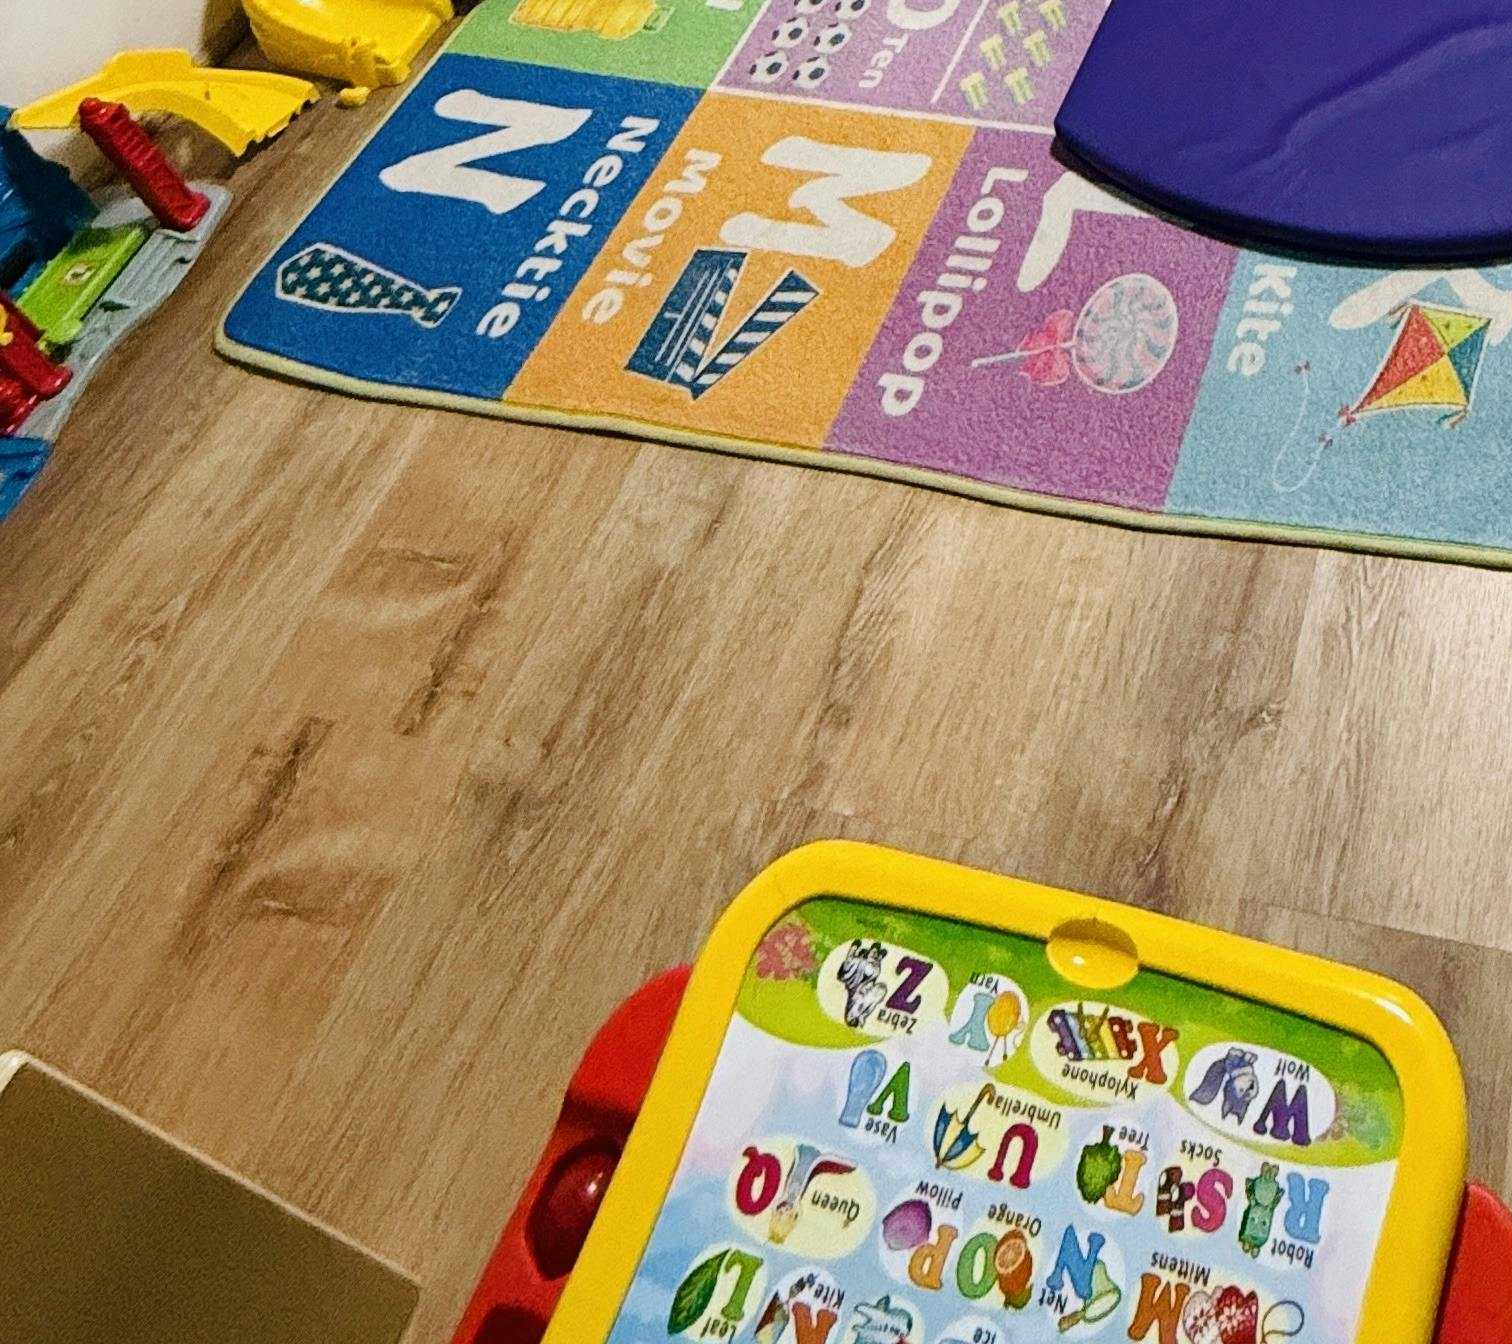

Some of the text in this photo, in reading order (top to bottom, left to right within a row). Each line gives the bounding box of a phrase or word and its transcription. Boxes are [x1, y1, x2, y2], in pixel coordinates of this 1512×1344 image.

[858, 27, 909, 93] Ten
[377, 86, 594, 217] N
[475, 114, 661, 341] Necktie
[718, 134, 935, 270] M
[579, 148, 724, 326] Movie
[878, 165, 1030, 418] Lollipop
[1224, 262, 1299, 380] Kite
[886, 954, 935, 1016] Z
[968, 970, 1001, 994] Yarn
[876, 1010, 919, 1036] Zebra
[948, 991, 998, 1054] Y
[1127, 1022, 1181, 1086] X
[866, 1060, 912, 1123] V
[1060, 1062, 1140, 1102] Xylophone
[1272, 1055, 1312, 1083] Wolf
[864, 1118, 901, 1146] Vase
[988, 1090, 1062, 1131] Umbrella
[1118, 1125, 1151, 1152] Tree
[1251, 1079, 1313, 1148] W
[734, 1144, 783, 1217] Q
[986, 1122, 1040, 1191] U
[1102, 1149, 1148, 1217] T
[1178, 1137, 1224, 1166] Socks
[810, 1189, 861, 1230] Queen
[914, 1179, 964, 1212] Pillow
[987, 1202, 1043, 1239] Orange
[1189, 1167, 1234, 1235] S
[1283, 1171, 1331, 1246] R
[907, 1223, 959, 1292] P
[955, 1231, 999, 1301] O
[1045, 1223, 1108, 1304] N
[1150, 1250, 1212, 1287] Mittens
[1269, 1237, 1316, 1270] Robot
[718, 1248, 766, 1323] L
[812, 1274, 846, 1312] Kite
[1037, 1287, 1069, 1315] Net
[701, 1315, 739, 1341] Leaf
